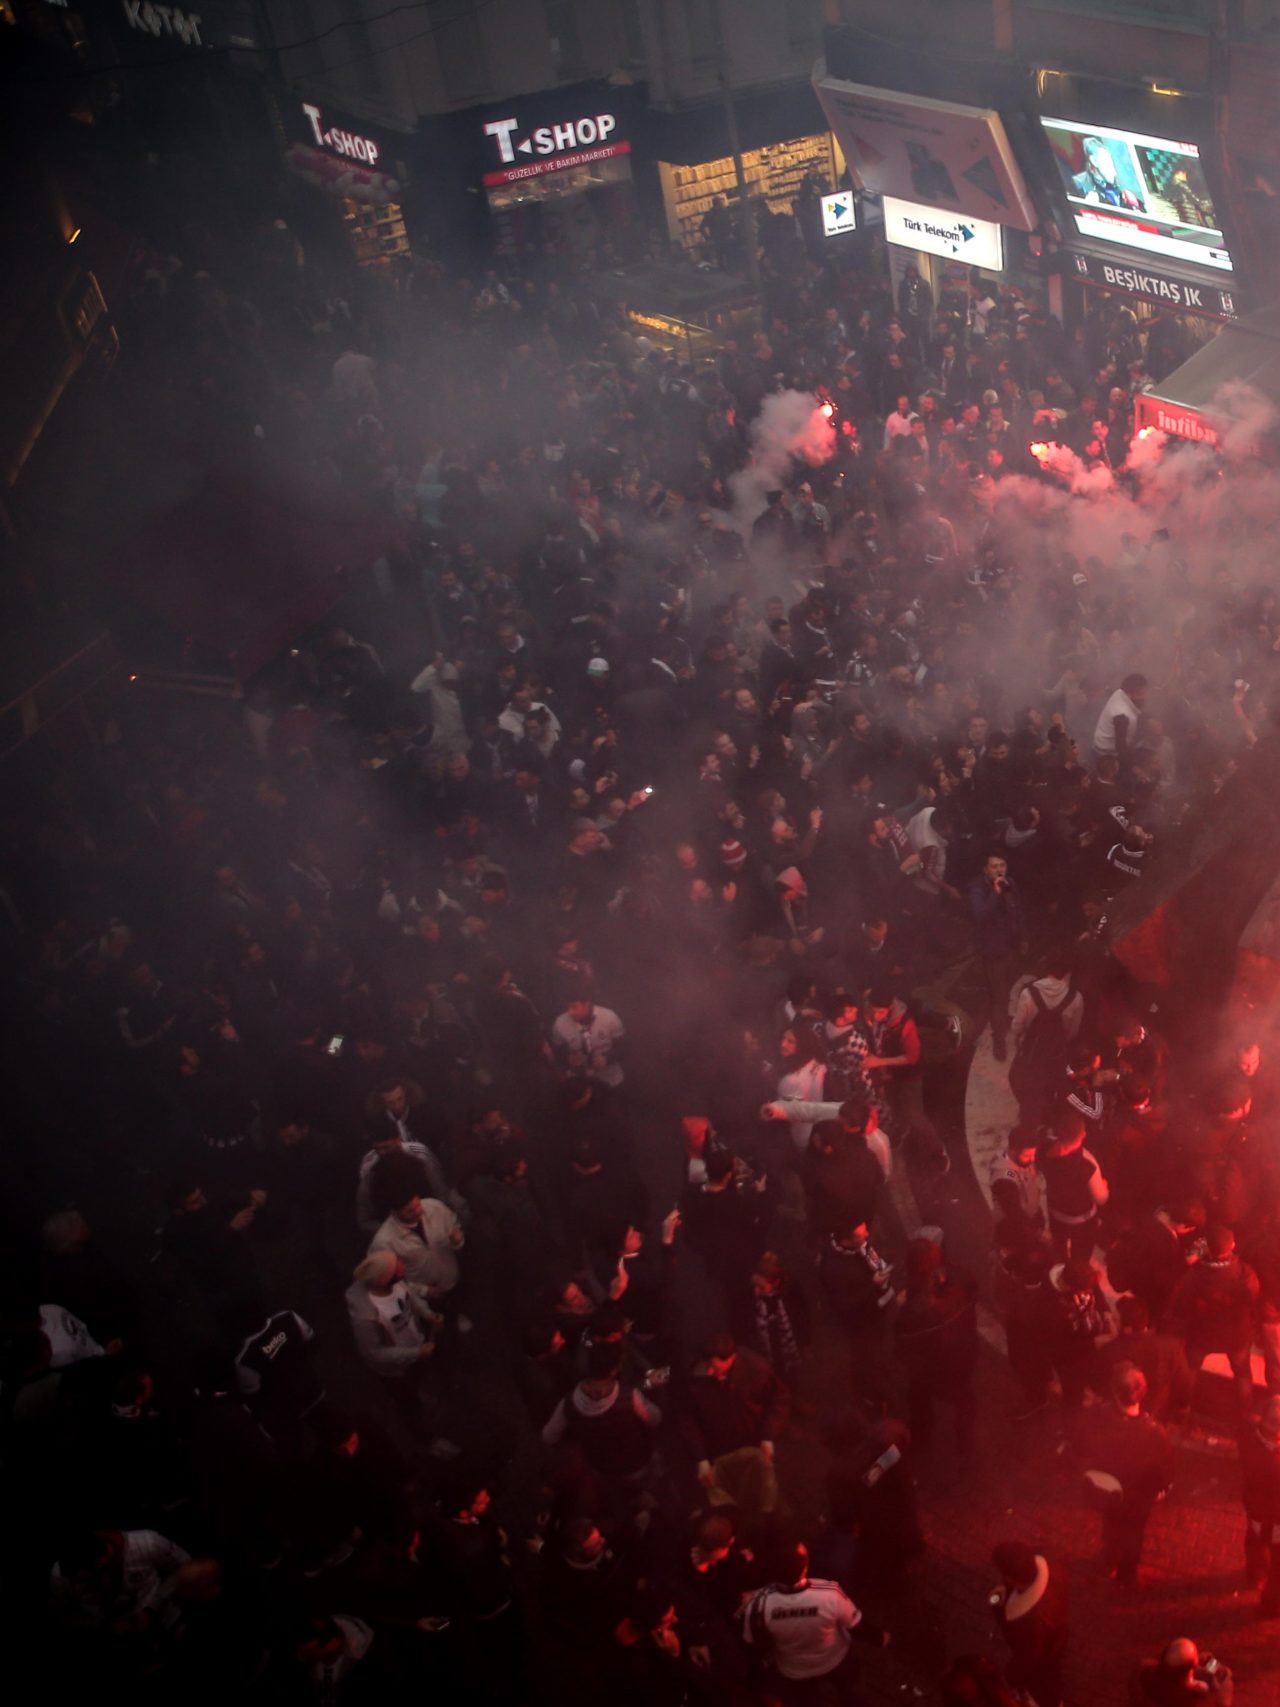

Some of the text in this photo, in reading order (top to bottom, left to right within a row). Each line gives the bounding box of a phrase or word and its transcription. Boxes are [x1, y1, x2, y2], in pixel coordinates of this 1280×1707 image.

[331, 128, 378, 165] SHOP
[535, 114, 616, 154] SHOP
[546, 162, 554, 171] VE
[557, 155, 580, 168] BAKIM
[903, 217, 960, 241] Türk Telekom
[1103, 266, 1203, 306] BEŞİKTAŞ JK
